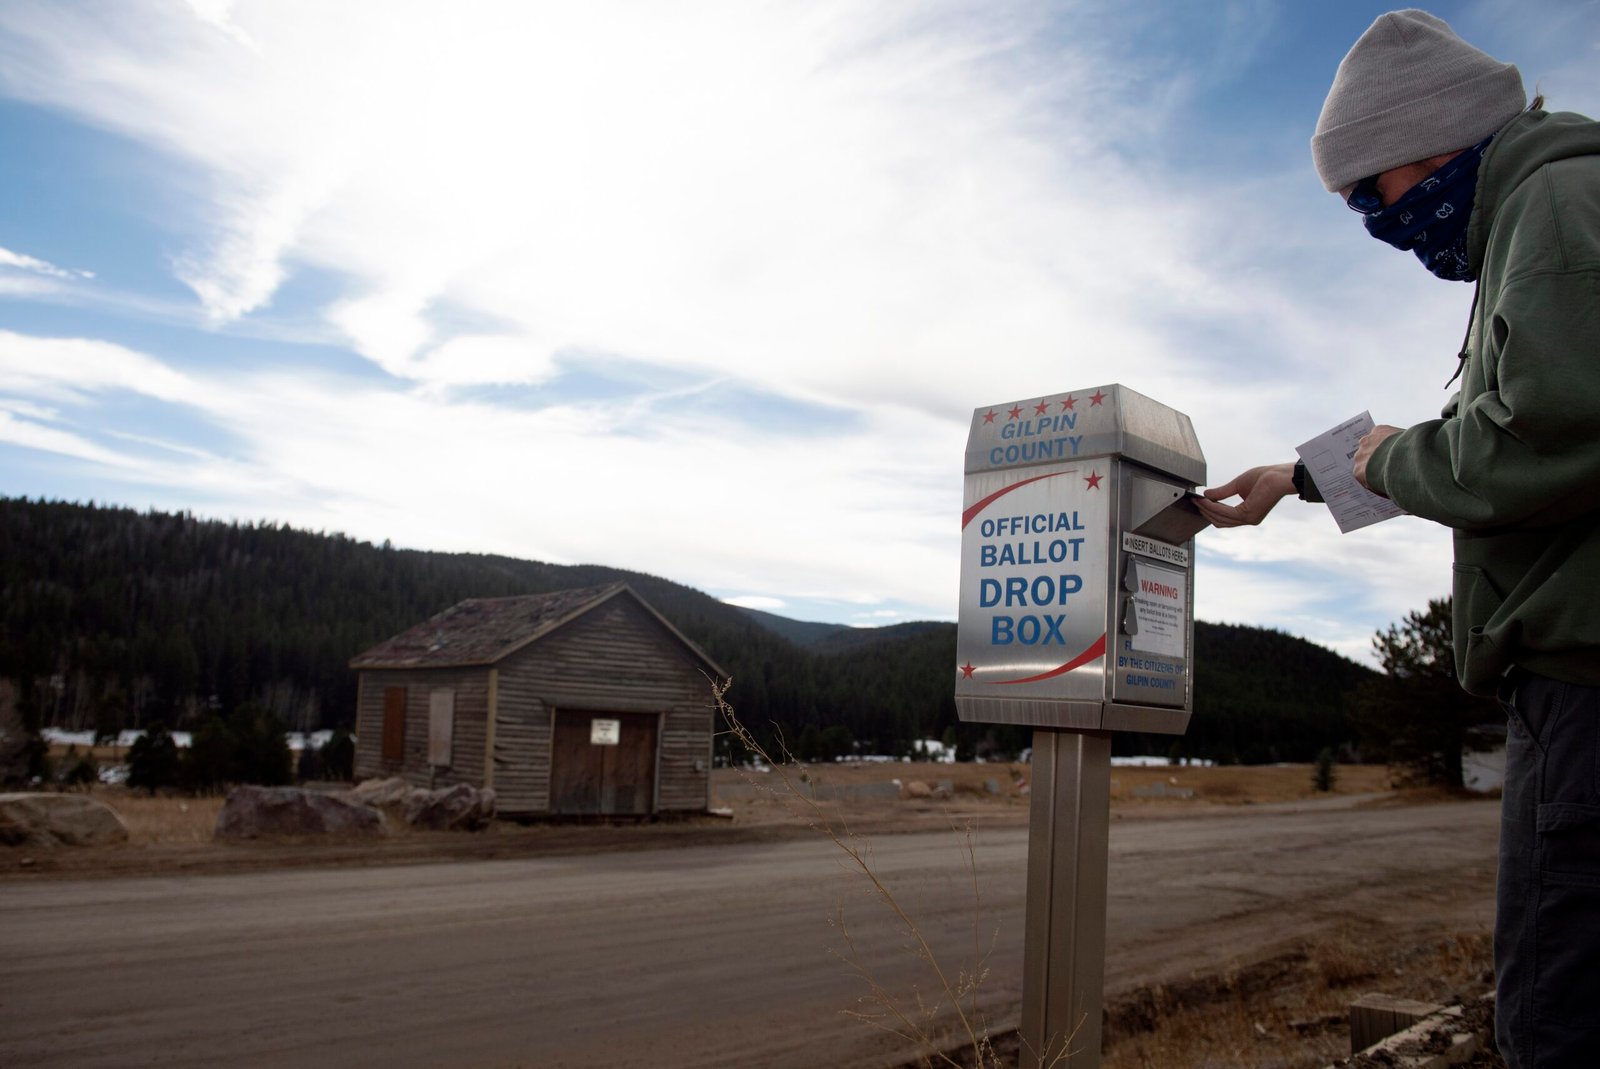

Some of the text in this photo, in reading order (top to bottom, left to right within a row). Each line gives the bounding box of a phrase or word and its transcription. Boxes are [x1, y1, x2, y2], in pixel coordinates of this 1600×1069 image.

[1001, 413, 1077, 439] GILPIN
[989, 435, 1083, 465] COUNTY
[981, 511, 1085, 538] OFFICIAL
[980, 538, 1085, 567] BALLOT
[1129, 538, 1184, 562] INSERT BALLOTS HERE
[980, 574, 1083, 608] DROP
[1141, 579, 1178, 600] WARNING
[991, 614, 1067, 646] BOX
[1119, 656, 1184, 674] BY THE CITIZENS OF
[1126, 674, 1176, 689] GILPIN COUNTY
